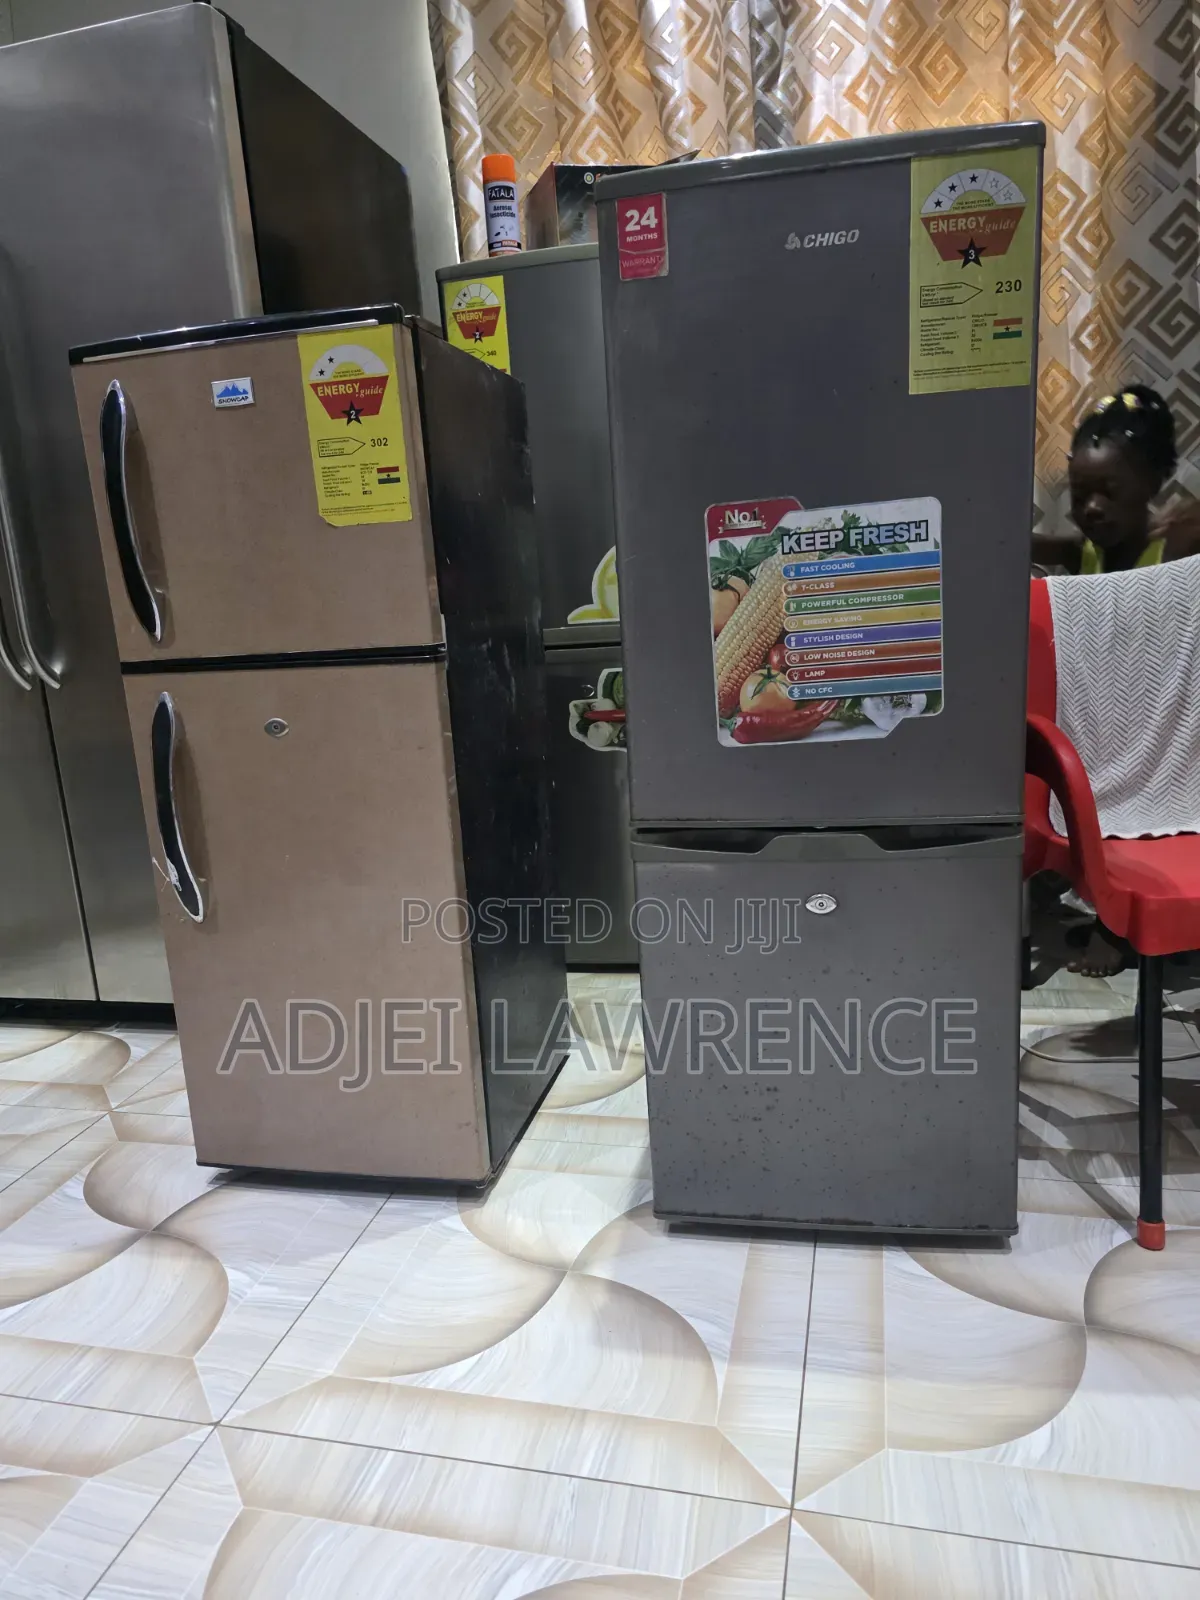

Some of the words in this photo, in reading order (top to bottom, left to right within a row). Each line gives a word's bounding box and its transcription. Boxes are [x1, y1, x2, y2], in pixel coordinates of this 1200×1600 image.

[488, 187, 514, 198] FATALA
[625, 206, 659, 232] 24
[929, 216, 986, 234] ENERGY
[986, 220, 1016, 235] guide
[626, 232, 658, 242] MONTHS
[803, 229, 860, 248] CHIGO
[968, 249, 976, 260] 3
[995, 279, 1022, 294] 230
[456, 311, 483, 323] ENERGY
[317, 382, 360, 398] ENERGY
[360, 385, 383, 398] guide
[218, 395, 249, 404] SNOWCAP
[350, 410, 356, 419] 2
[370, 437, 389, 447] 302
[782, 530, 844, 555] KEEP
[849, 520, 929, 548] FRESH
[800, 565, 819, 574] FAST
[820, 562, 855, 572] COOLING
[801, 582, 835, 591] T-CLASS
[801, 599, 846, 609] POWERFUL
[848, 593, 904, 605] COMPRESSOR
[802, 617, 833, 626] ENERGY
[834, 614, 862, 624] SAVING
[803, 635, 834, 644] STYLISH
[835, 632, 863, 641] DESIGN
[803, 653, 822, 661] LOW
[822, 651, 846, 659] NOISE
[847, 649, 875, 657] DESIGN
[804, 670, 825, 678] LAMP
[805, 687, 817, 695] NO
[818, 686, 833, 694] CFC
